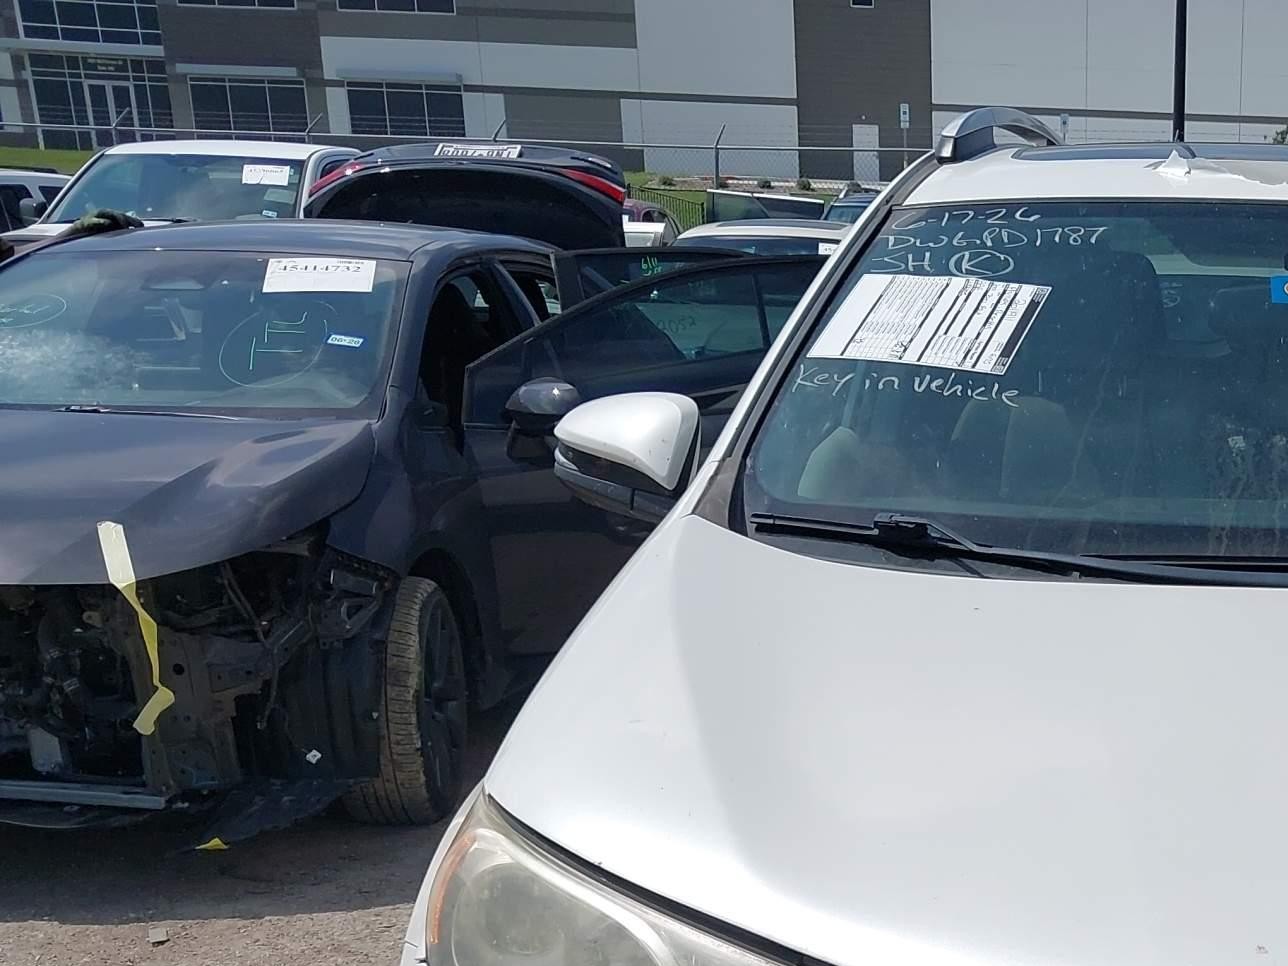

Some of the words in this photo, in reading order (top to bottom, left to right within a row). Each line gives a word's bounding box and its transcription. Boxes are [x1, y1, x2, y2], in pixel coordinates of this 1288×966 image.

[892, 207, 1041, 230] 6-17-26
[277, 264, 361, 273] 45414732
[865, 373, 899, 391] in
